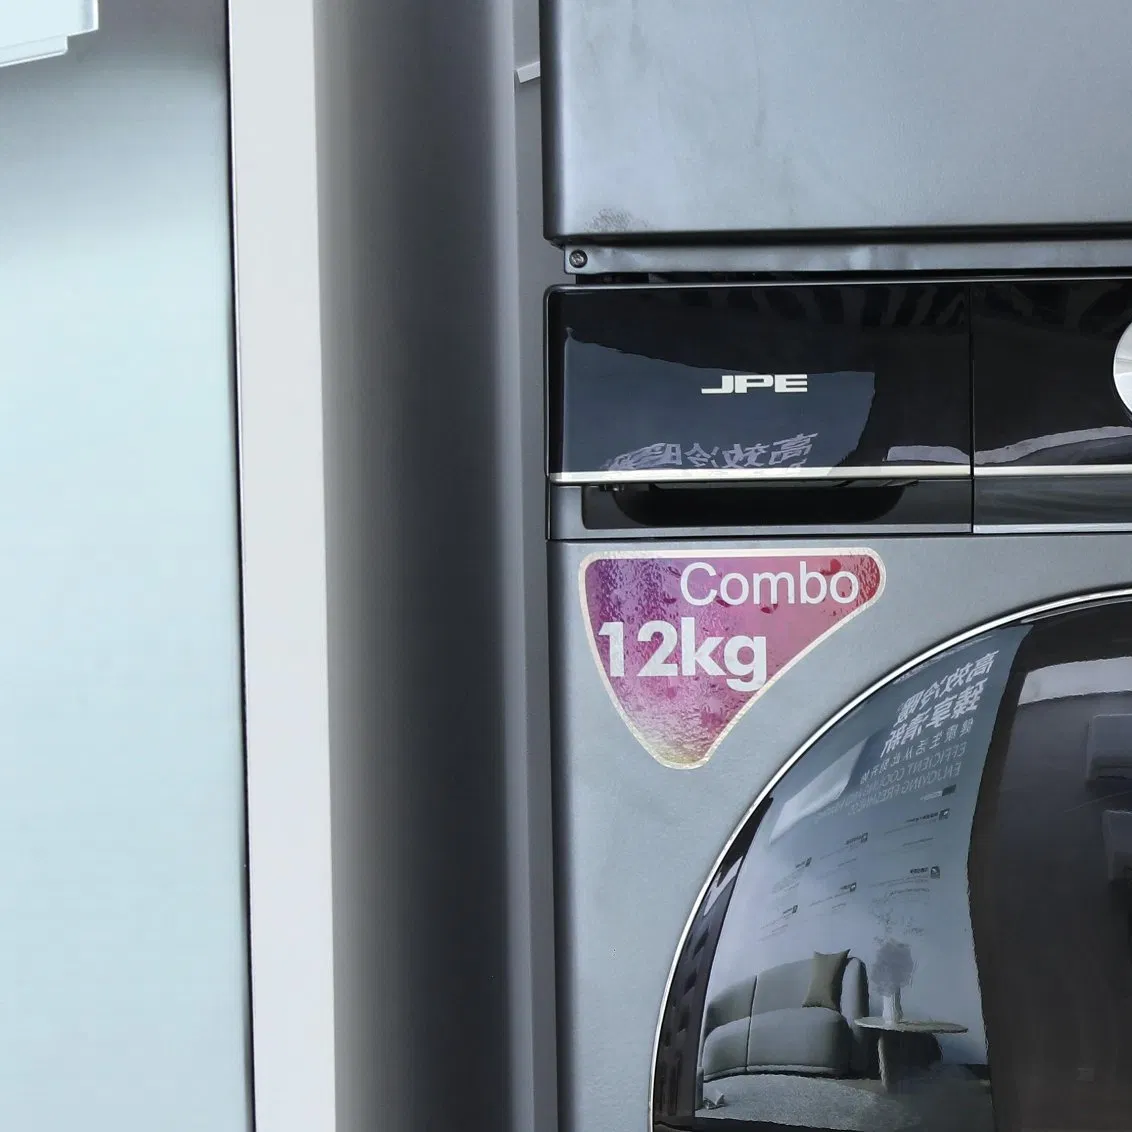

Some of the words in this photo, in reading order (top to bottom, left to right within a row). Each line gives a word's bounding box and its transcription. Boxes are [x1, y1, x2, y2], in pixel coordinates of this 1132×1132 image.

[701, 374, 808, 394] JPE
[680, 561, 860, 605] Combo
[599, 616, 767, 692] 12kg
